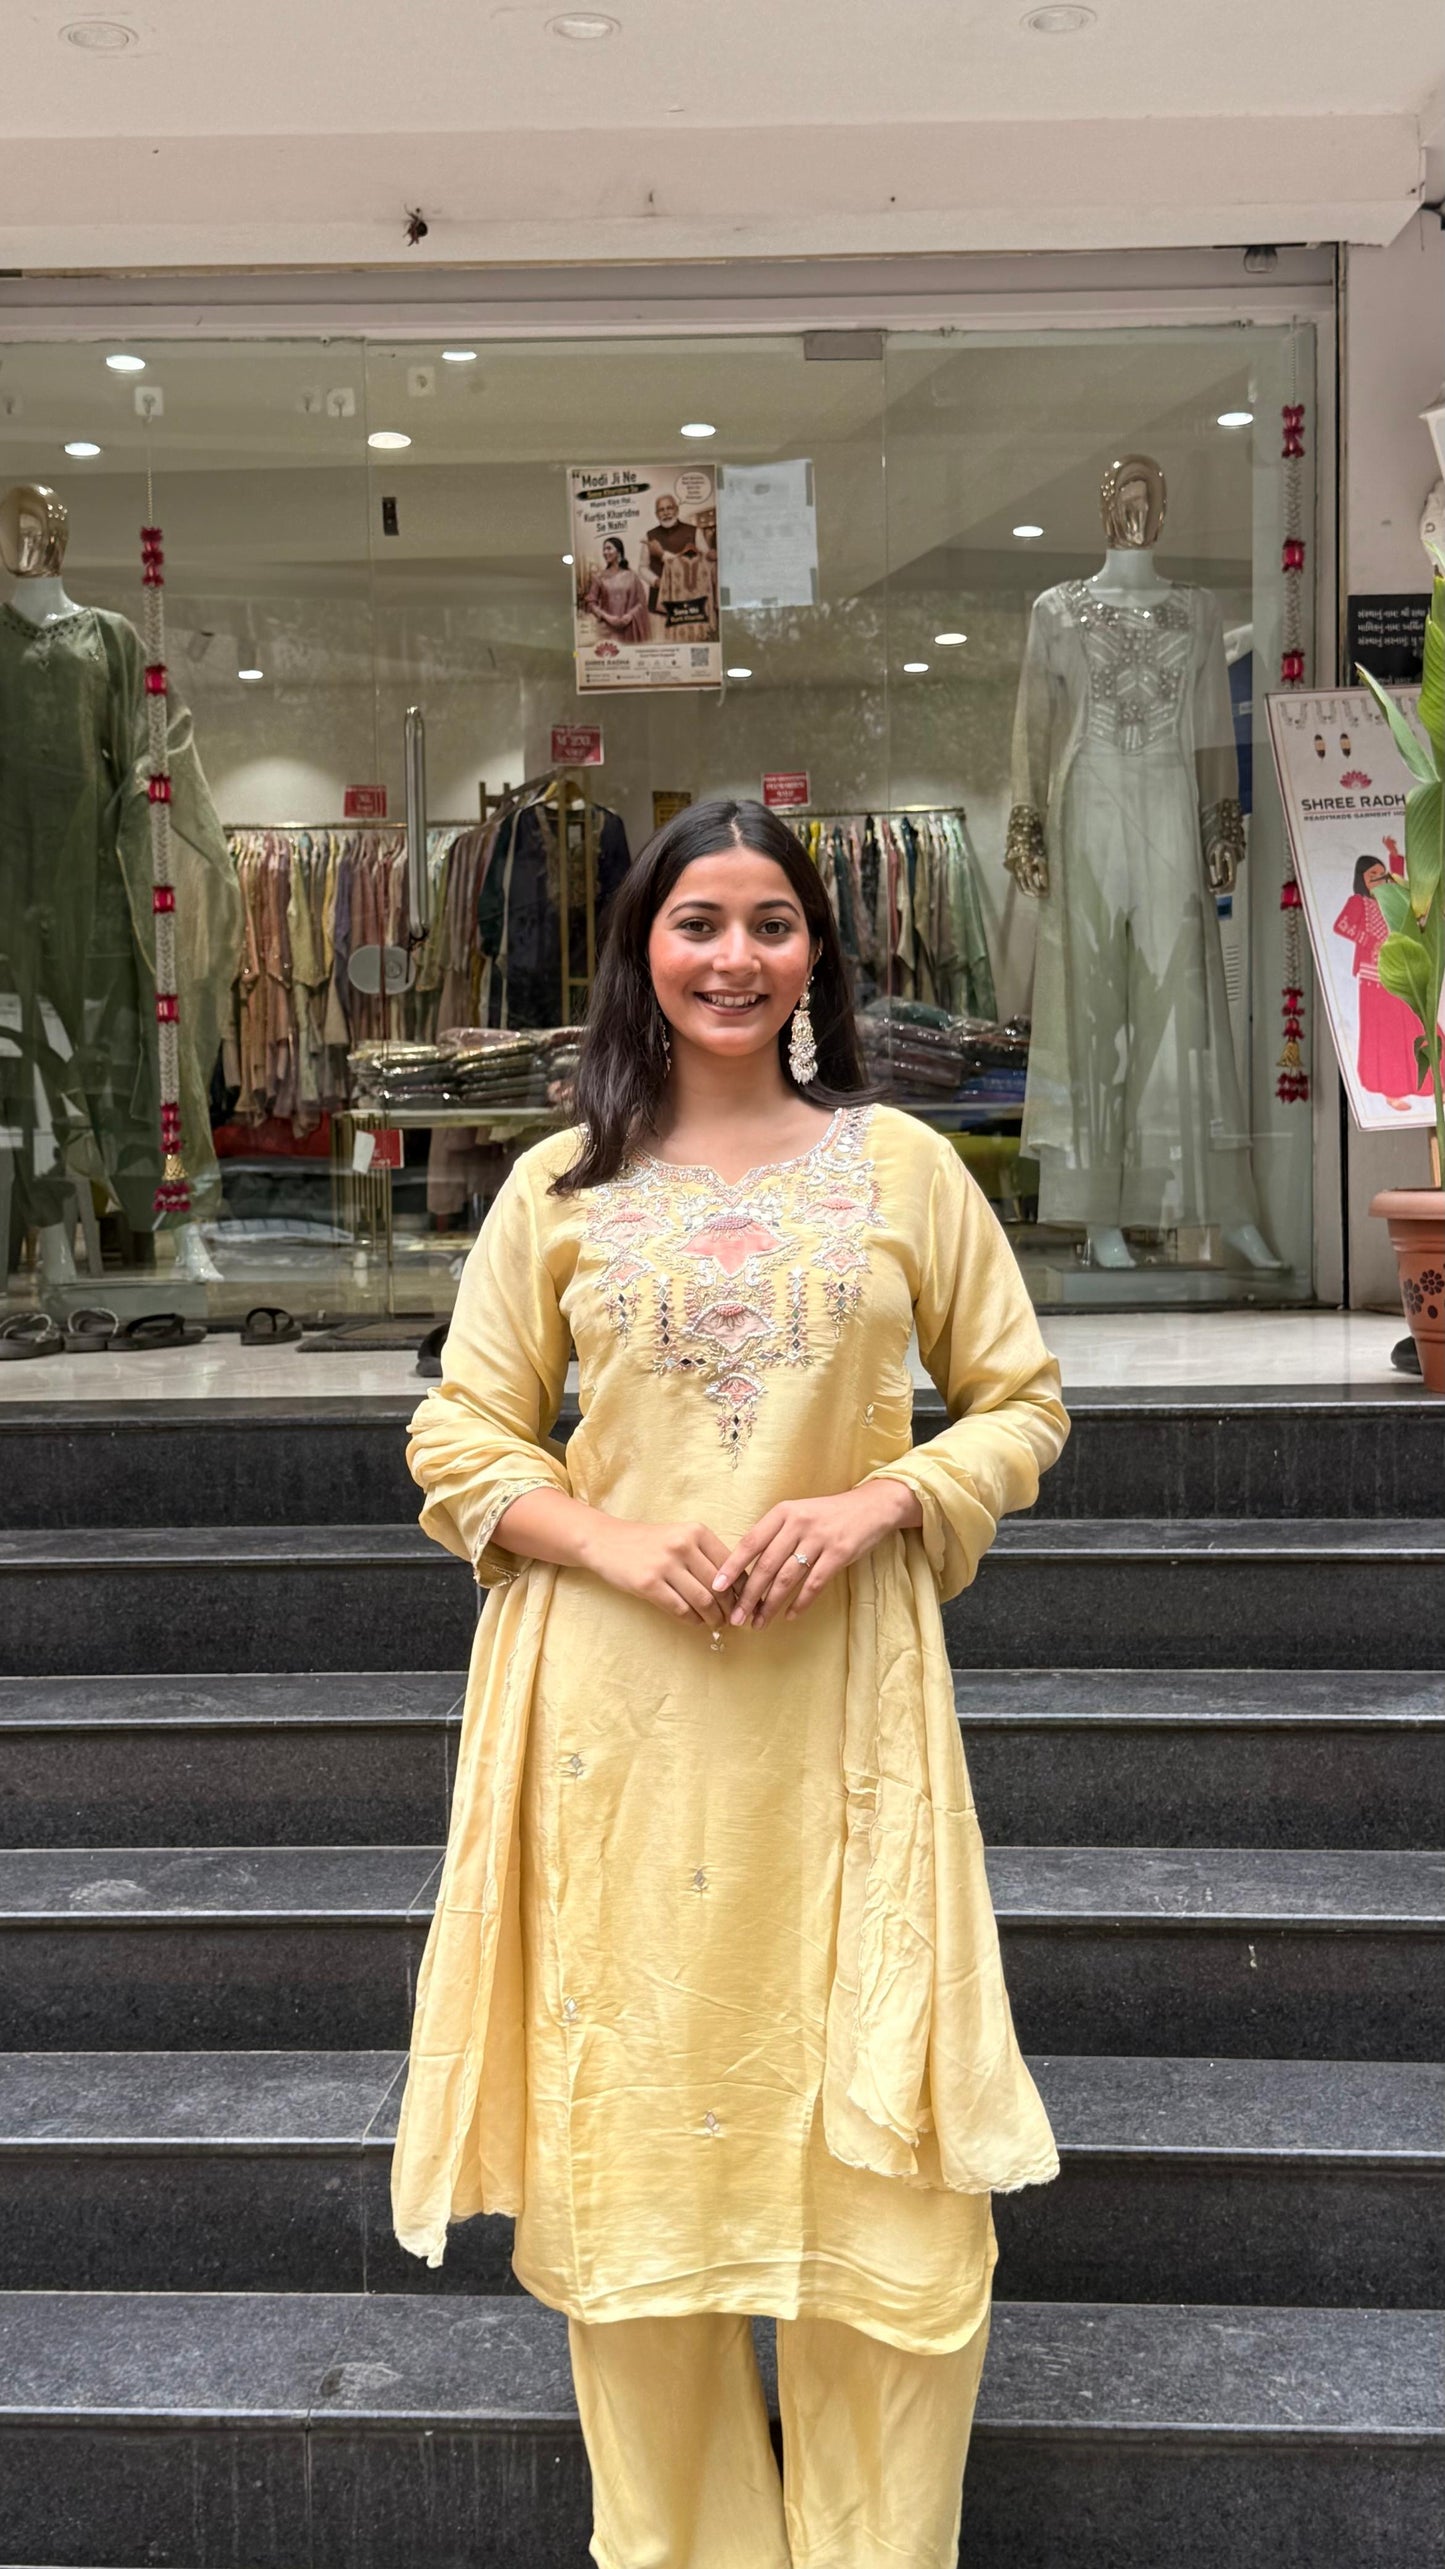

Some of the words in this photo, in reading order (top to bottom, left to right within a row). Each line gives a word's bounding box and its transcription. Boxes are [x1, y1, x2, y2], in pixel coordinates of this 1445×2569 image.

[611, 472, 620, 485] Ji
[623, 470, 637, 483] Ne
[607, 508, 640, 519] Kharidne
[596, 523, 606, 532] Se
[1301, 797, 1356, 811] SHREE
[1360, 794, 1406, 808] RADH
[1303, 813, 1352, 821] READYMADE
